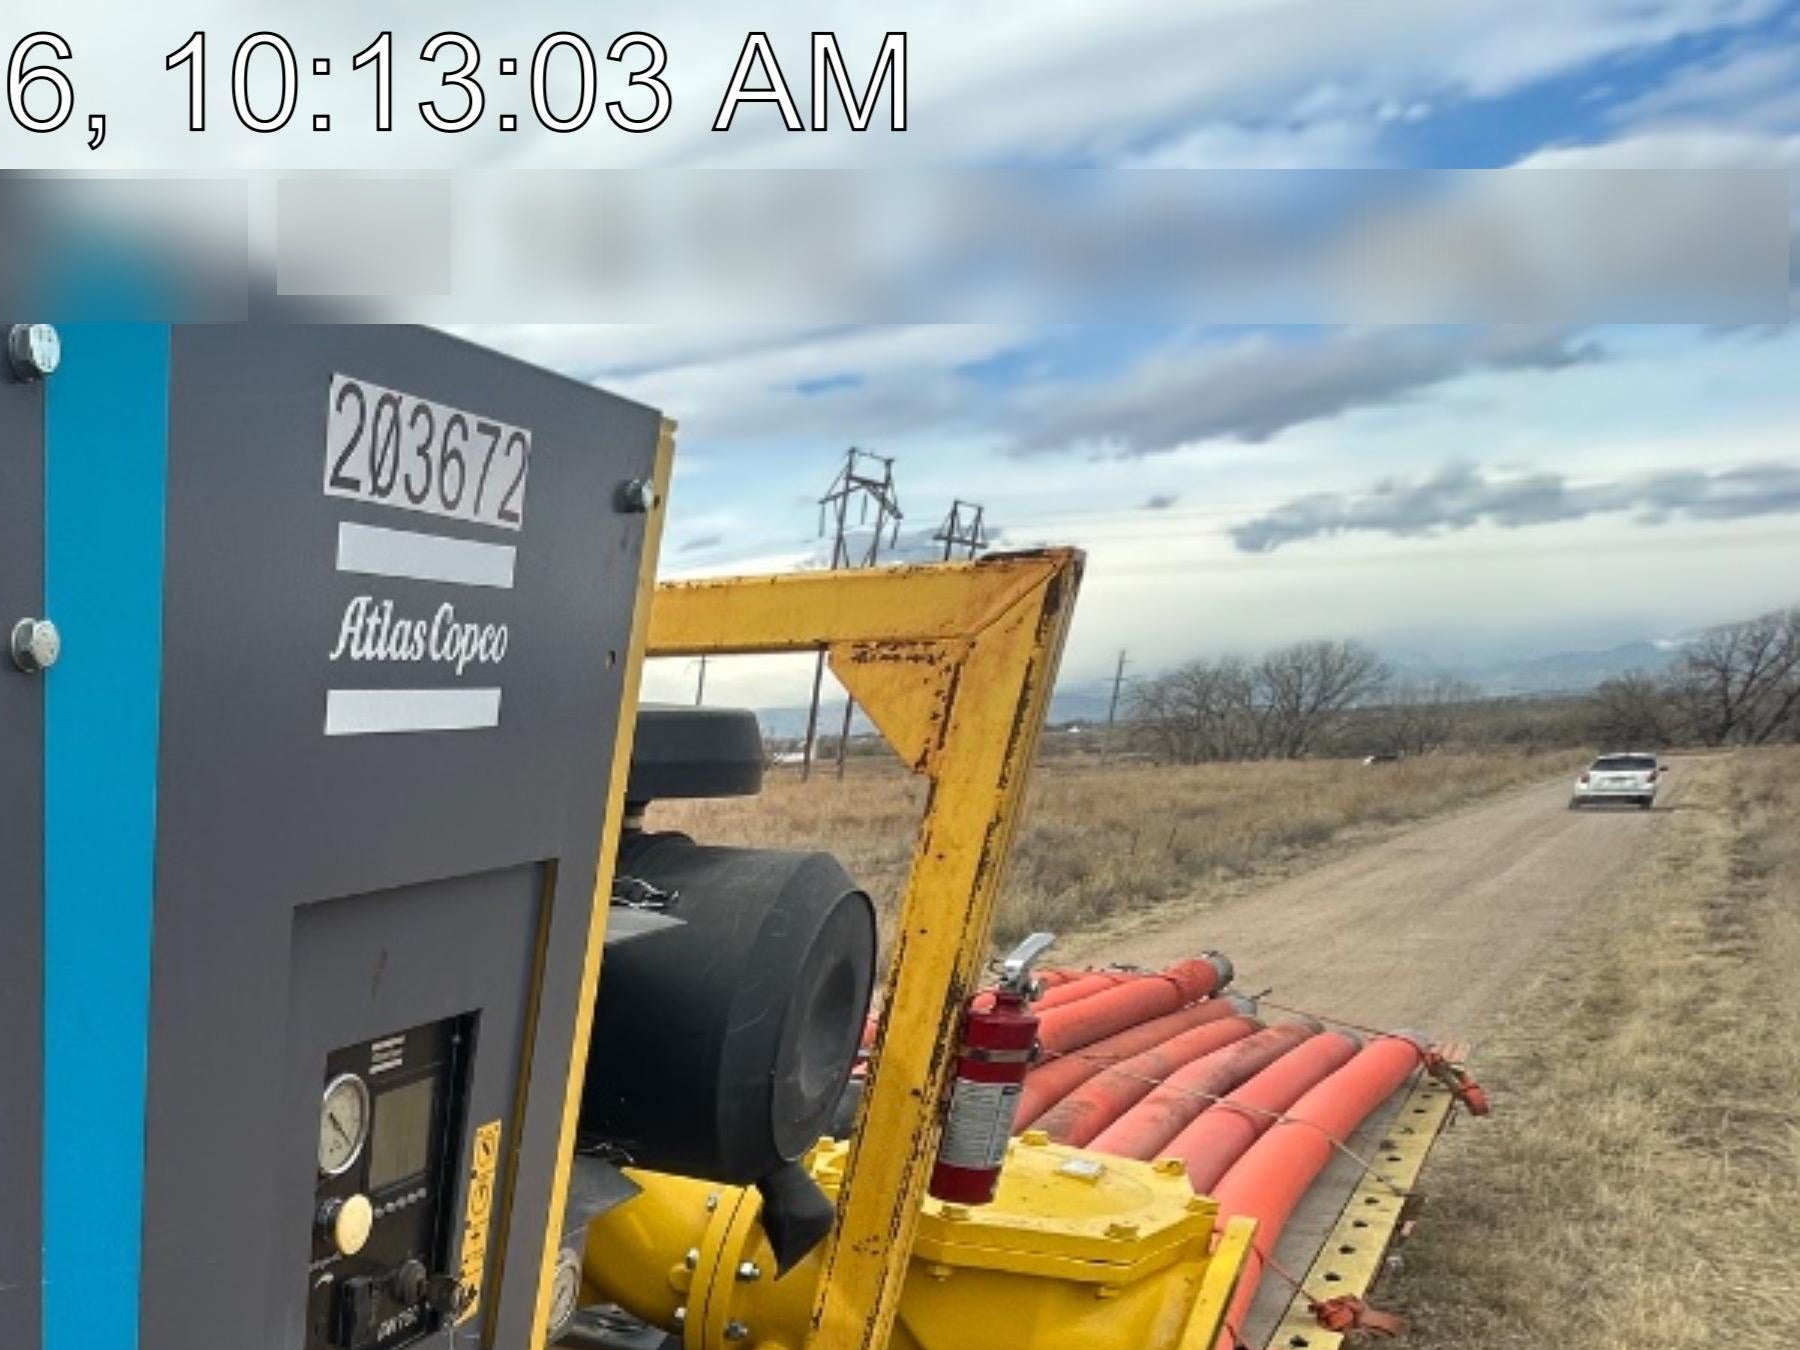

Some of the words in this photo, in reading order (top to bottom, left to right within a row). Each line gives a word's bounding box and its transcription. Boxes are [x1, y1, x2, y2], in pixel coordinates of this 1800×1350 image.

[329, 383, 529, 522] 203672
[329, 596, 428, 662] Atlas
[429, 602, 509, 676] Copco
